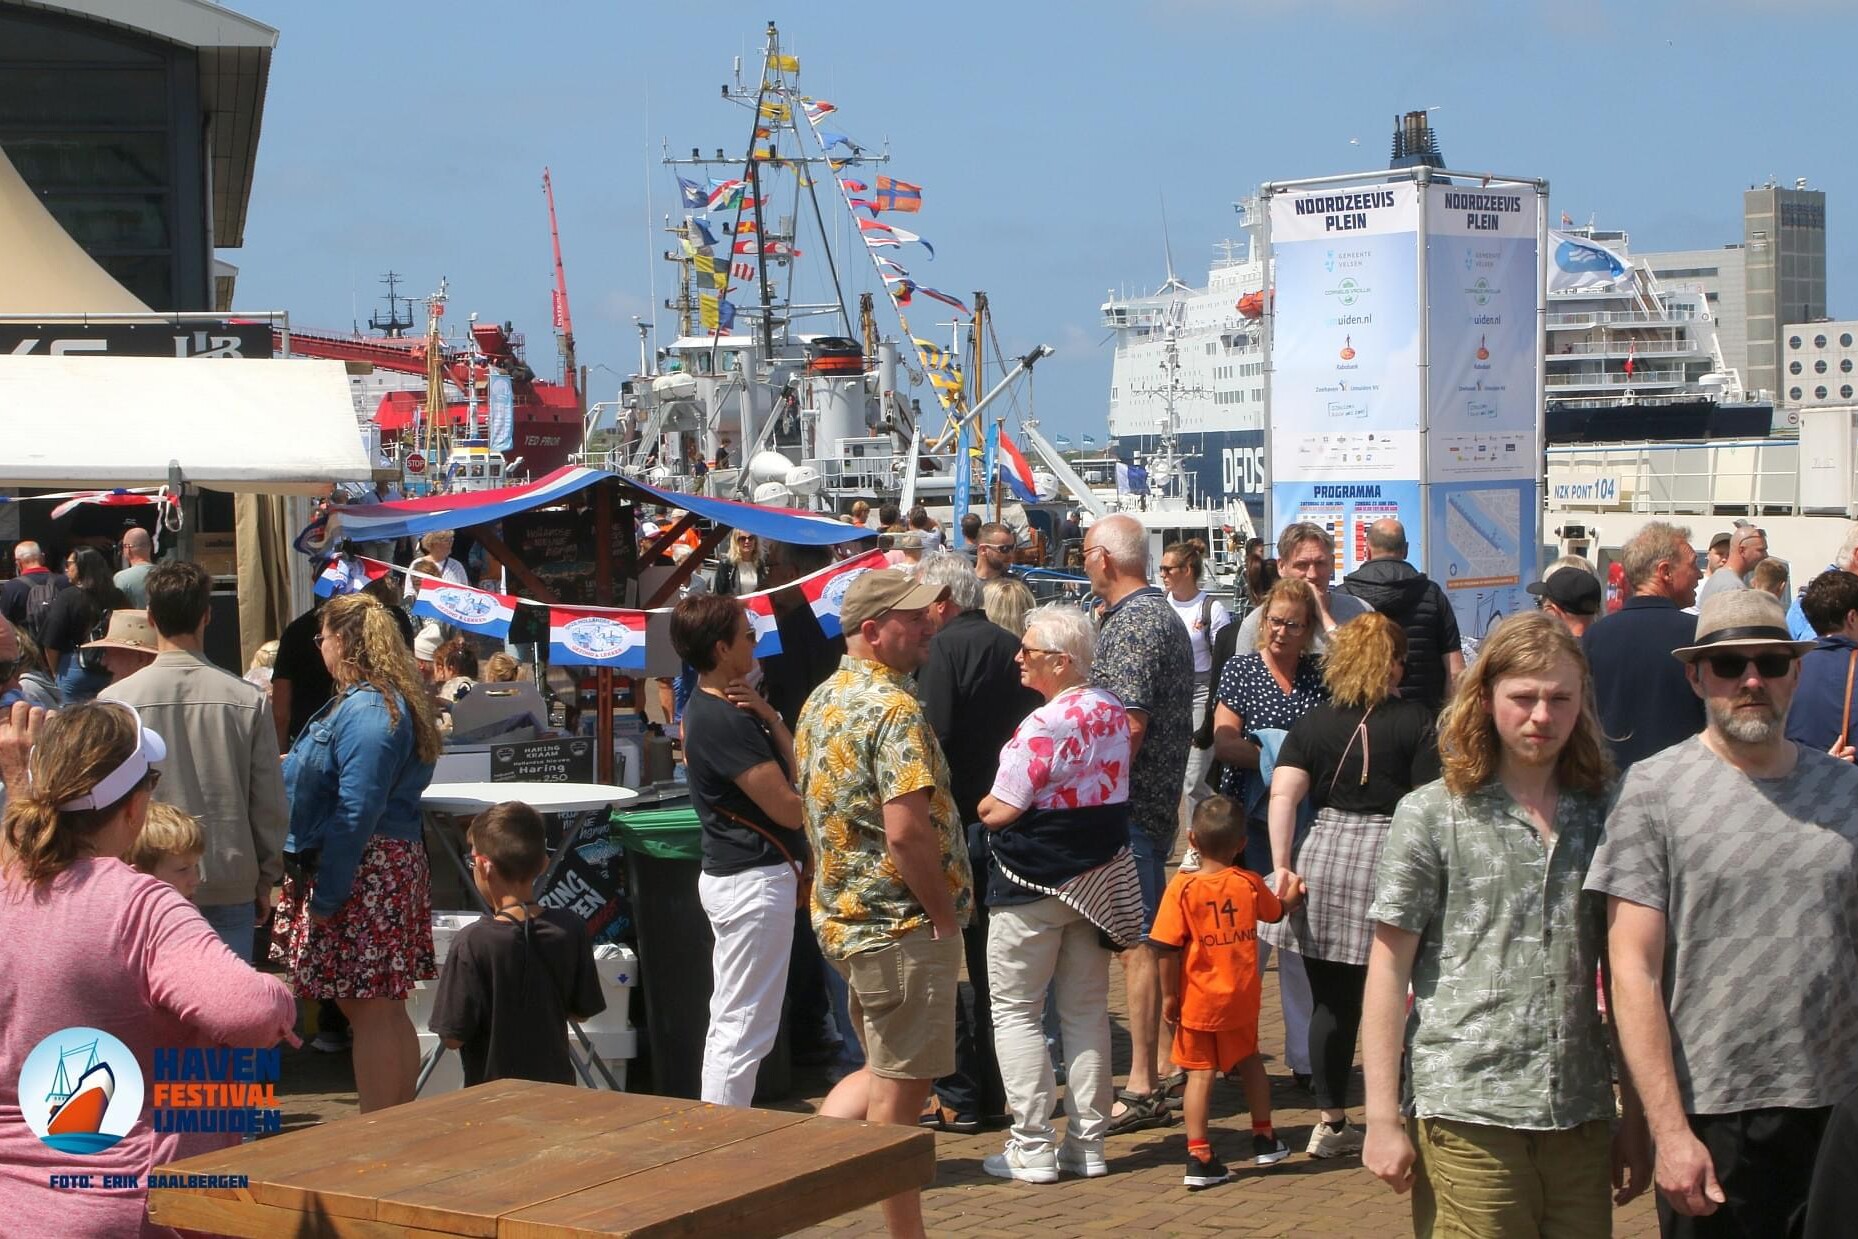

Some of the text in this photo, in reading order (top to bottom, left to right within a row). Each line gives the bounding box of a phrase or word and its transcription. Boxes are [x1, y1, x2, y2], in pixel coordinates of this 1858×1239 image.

[1295, 191, 1395, 215] NOORDZEEVIS
[1445, 193, 1521, 212] NOORDZEEVIS
[1326, 213, 1366, 231] PLEIN
[1467, 213, 1499, 230] PLEIN
[407, 459, 425, 469] STOP
[1222, 447, 1264, 494] DFDS
[1314, 485, 1382, 498] PROGRAMMA
[1554, 478, 1615, 500] NZK PONT 104
[524, 745, 560, 753] HARING
[526, 751, 558, 759] KRAAM
[519, 764, 566, 774] Haring
[1205, 898, 1239, 929] 14
